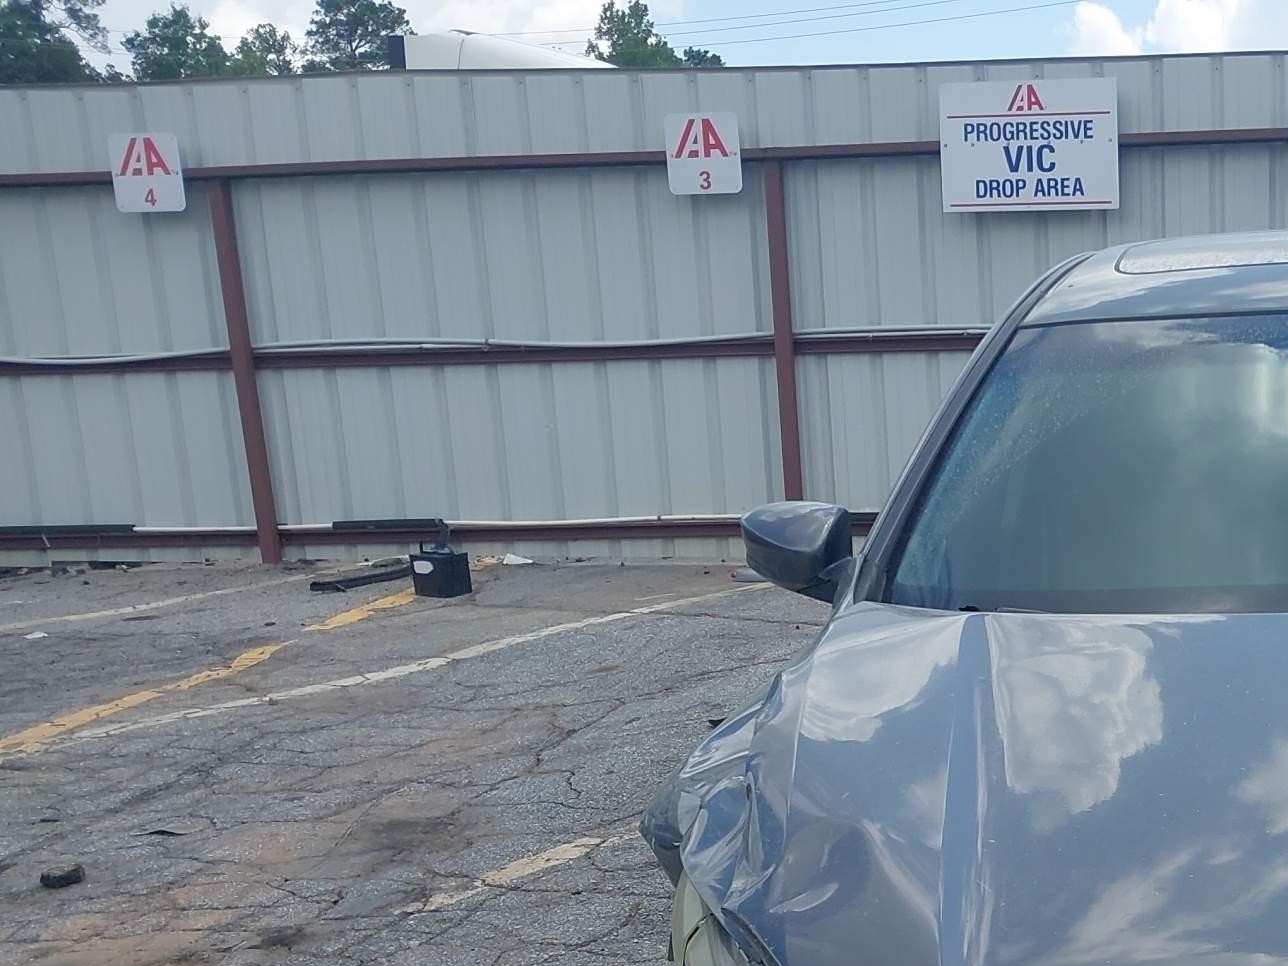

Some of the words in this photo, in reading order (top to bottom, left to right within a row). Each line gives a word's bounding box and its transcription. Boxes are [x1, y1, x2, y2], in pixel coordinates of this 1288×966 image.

[963, 120, 1094, 142] PROGRESSIVE
[1003, 144, 1056, 173] VIC
[699, 171, 712, 190] 3
[975, 179, 1027, 198] DROP
[1033, 177, 1085, 197] AREA
[144, 188, 157, 207] 4
